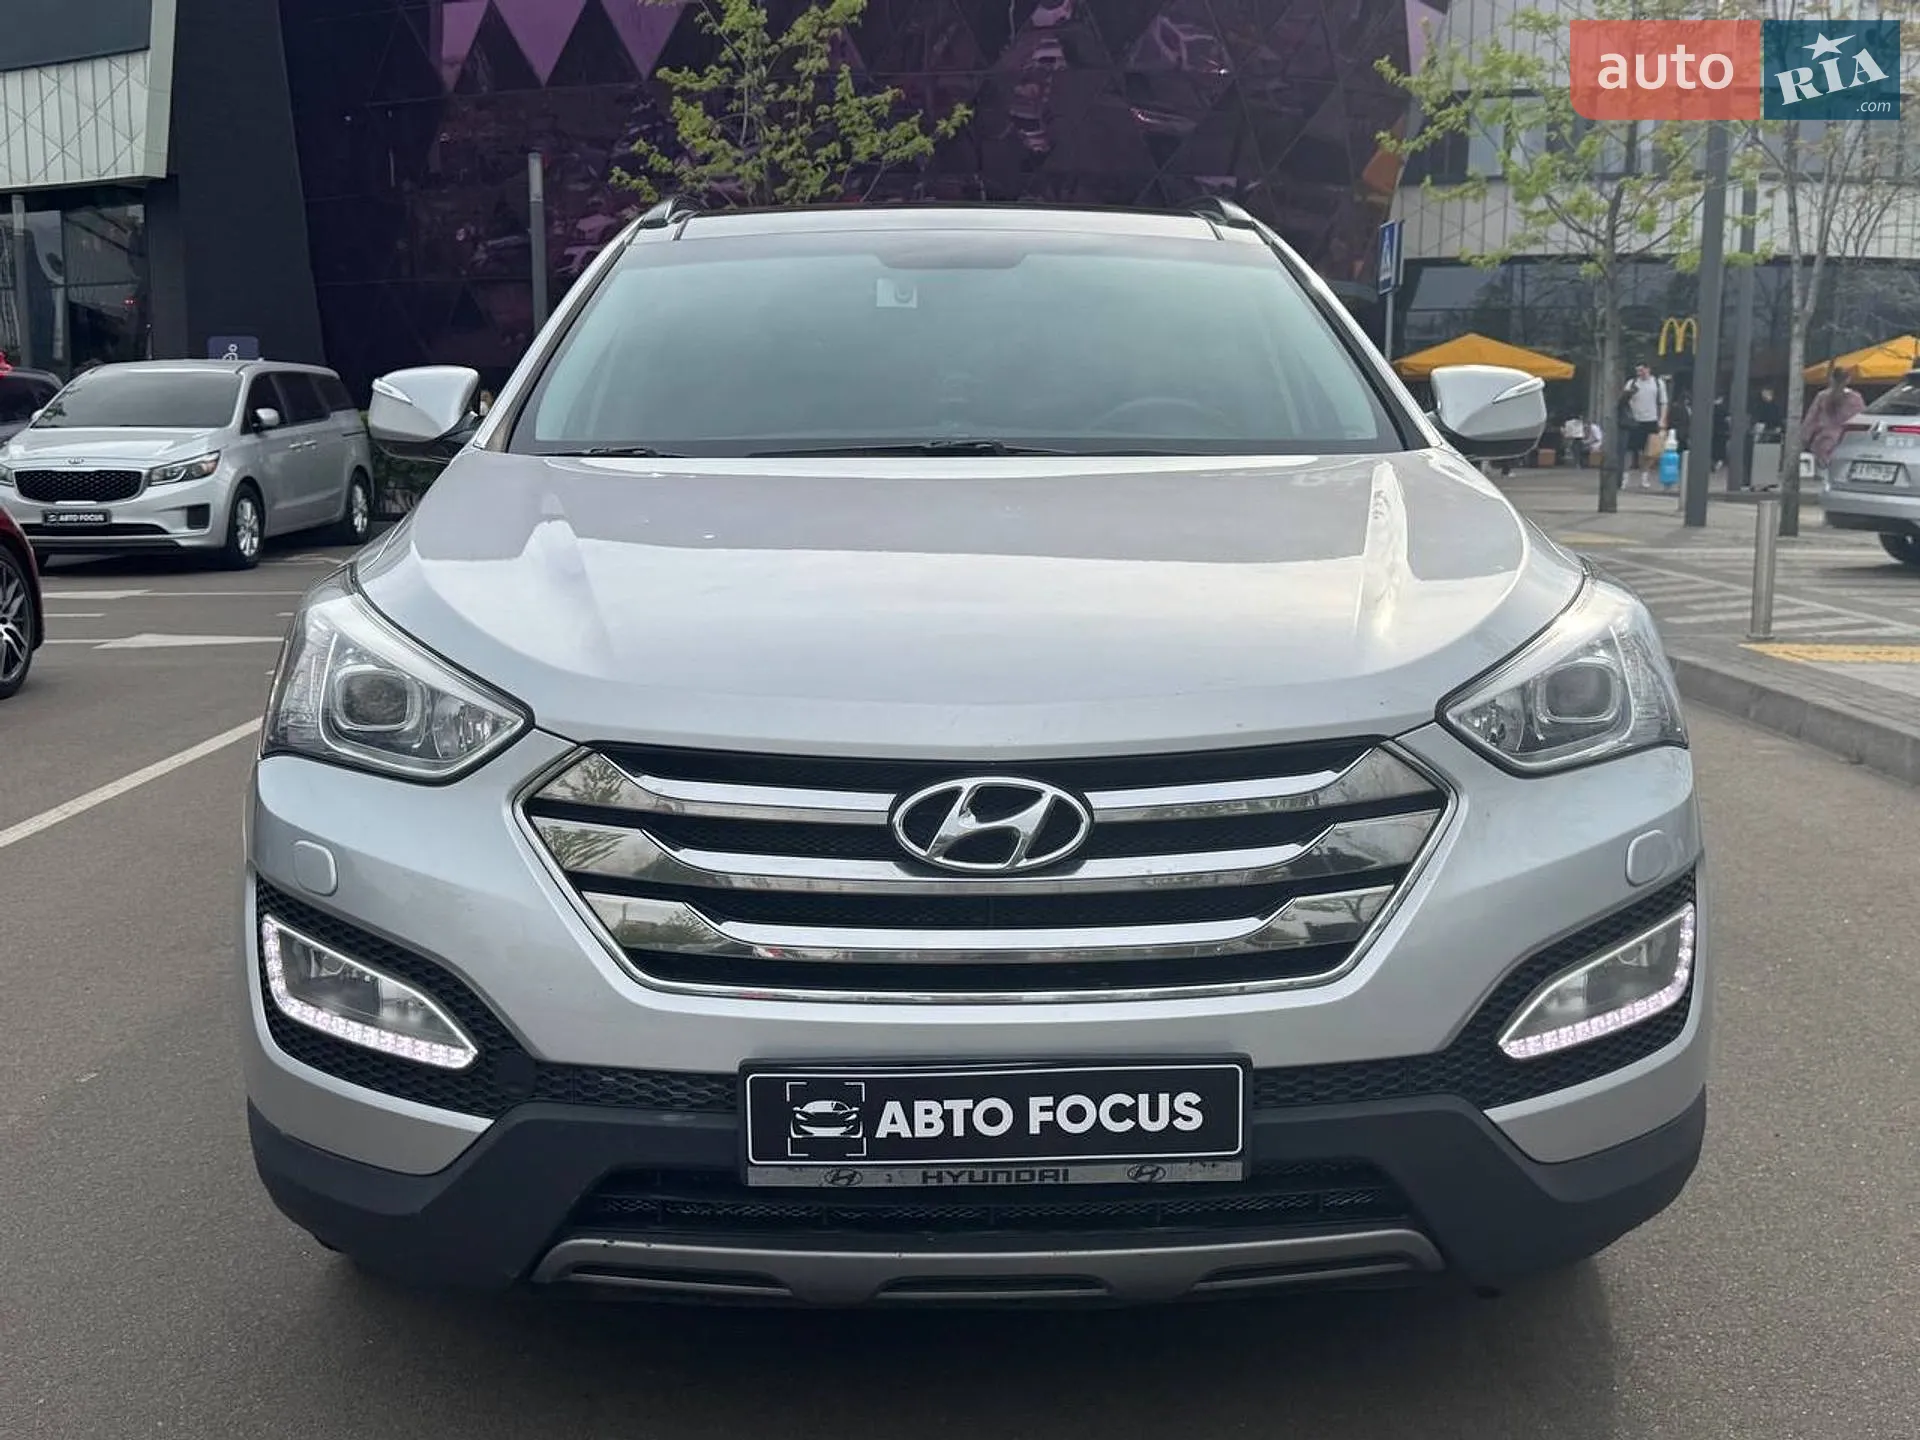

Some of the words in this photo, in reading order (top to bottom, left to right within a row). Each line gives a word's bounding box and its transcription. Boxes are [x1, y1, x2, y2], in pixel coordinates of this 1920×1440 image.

[875, 1097, 1014, 1138] АВТО
[1028, 1091, 1204, 1134] FOCUS
[921, 1168, 1070, 1185] HYUNDAI
